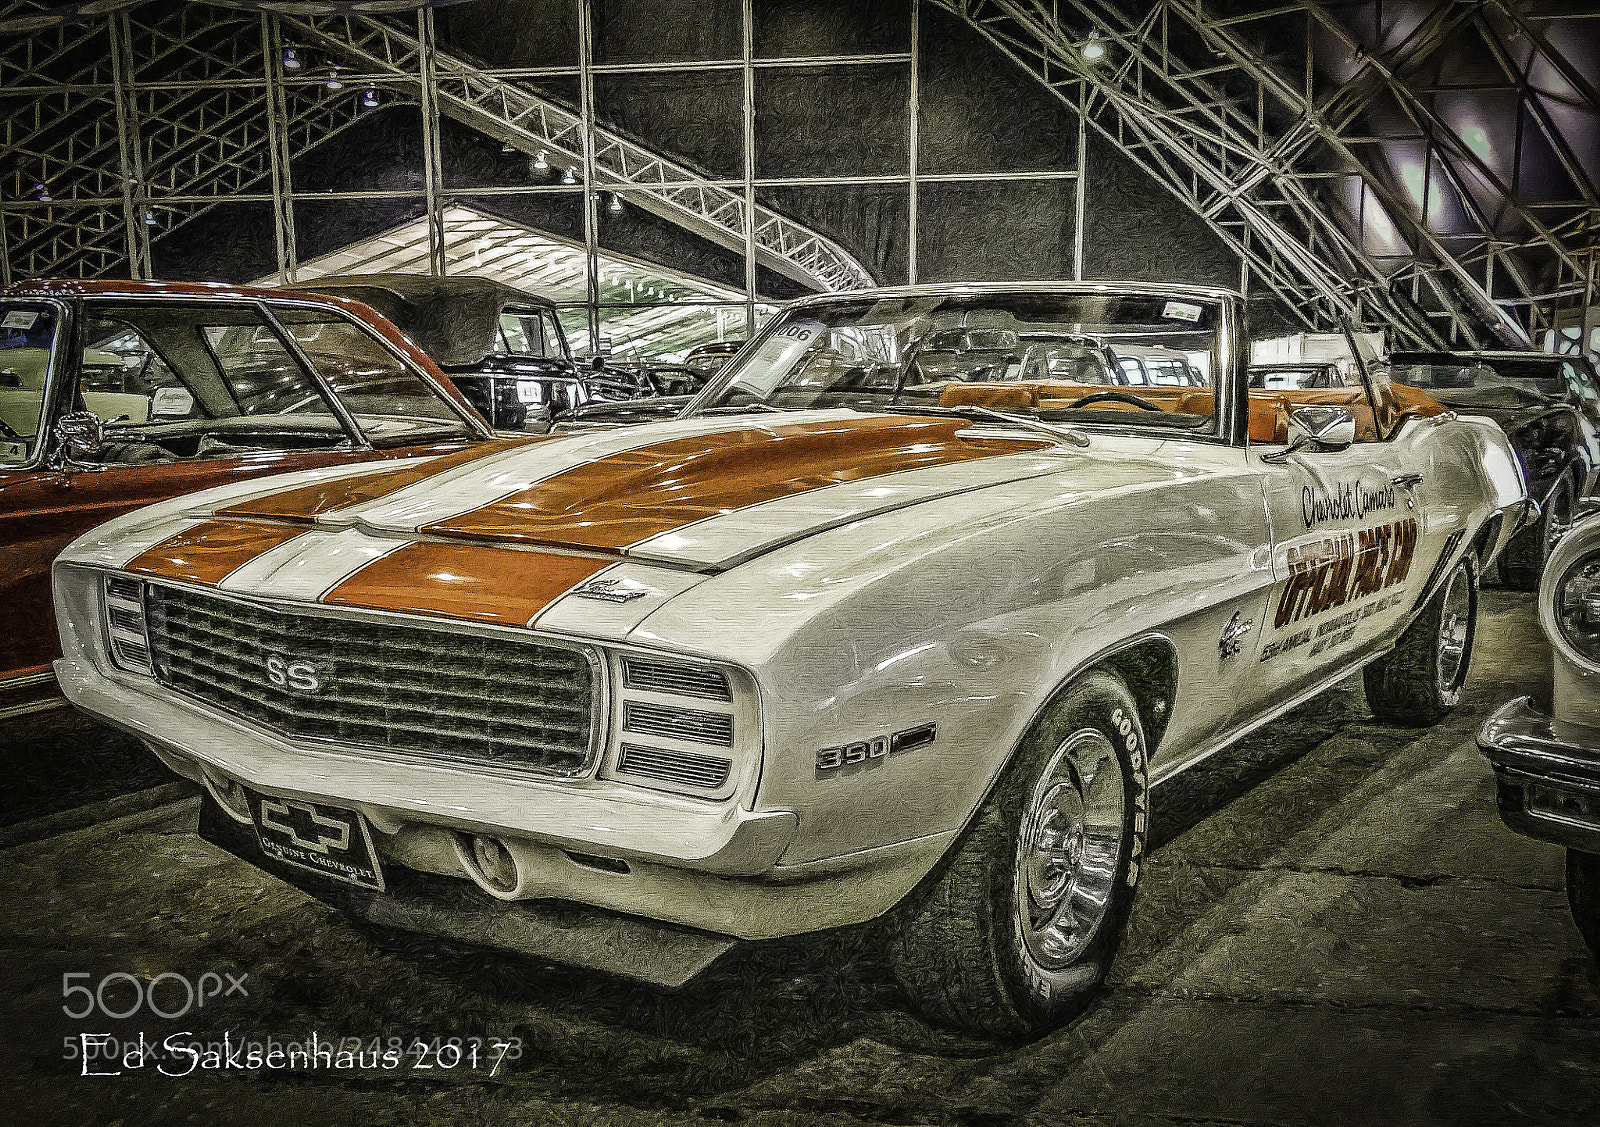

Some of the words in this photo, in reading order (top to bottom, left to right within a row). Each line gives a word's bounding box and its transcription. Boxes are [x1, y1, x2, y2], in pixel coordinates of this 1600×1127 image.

[1302, 481, 1355, 529] Chevrolet
[1355, 480, 1395, 520] Camaro
[267, 655, 319, 691] SS
[815, 734, 890, 770] 350
[1111, 707, 1146, 888] GOODYEAR
[309, 851, 373, 878] CHEVROLET
